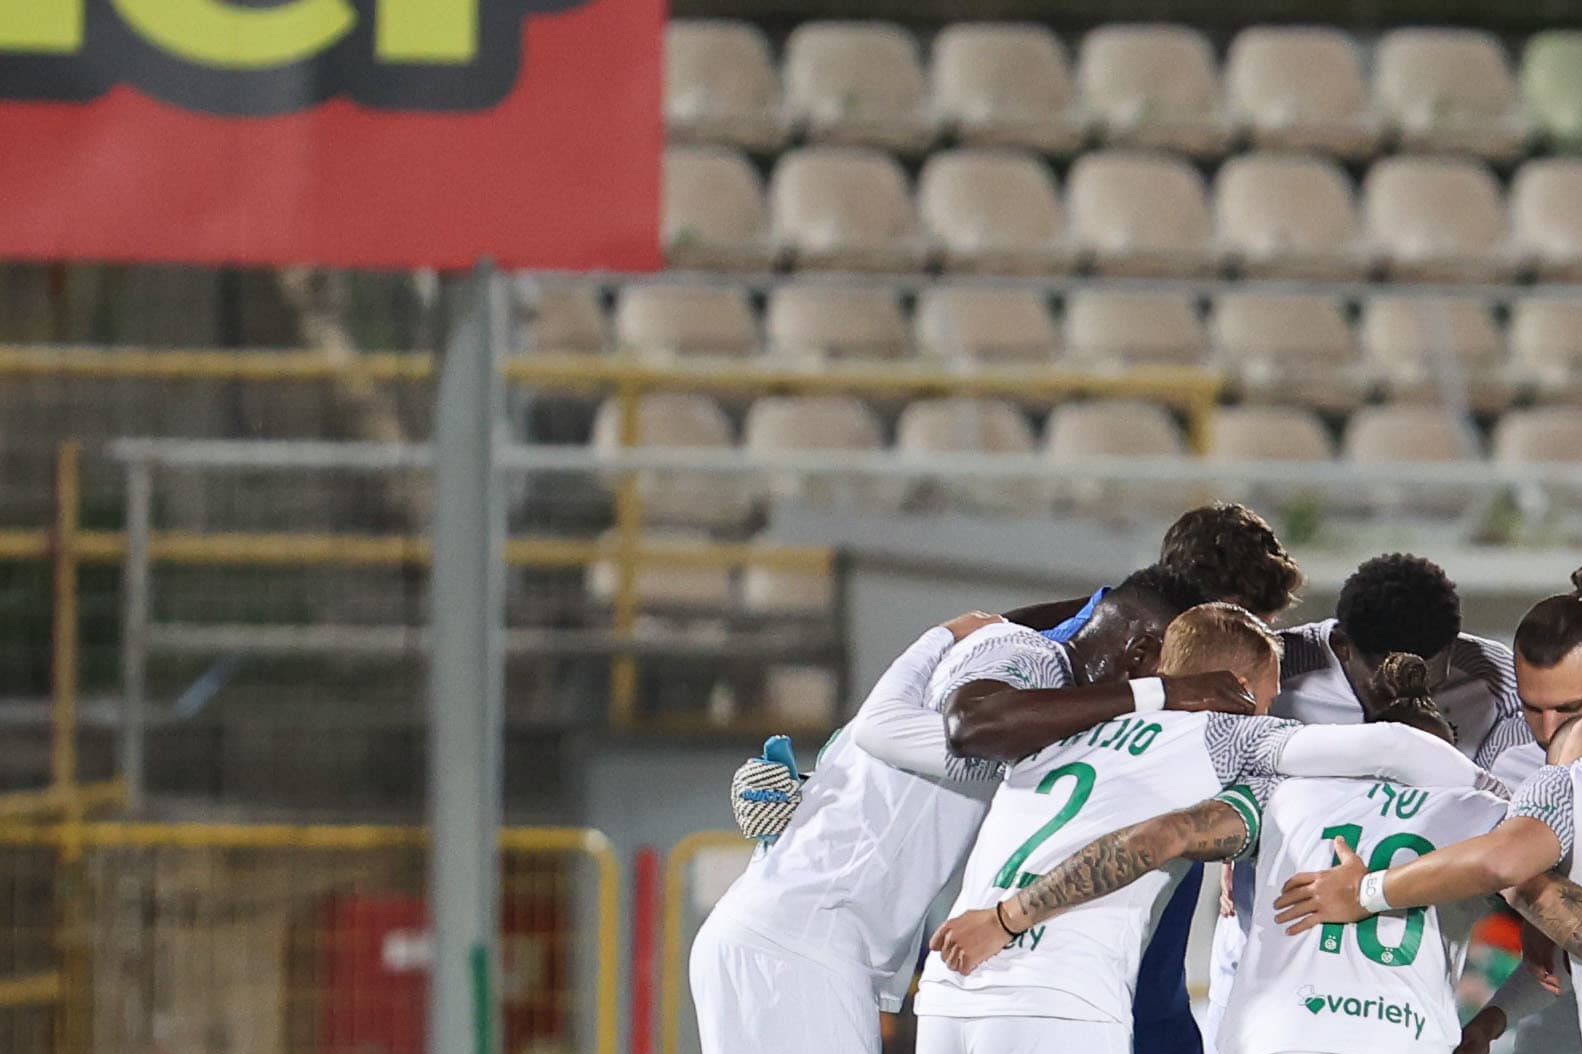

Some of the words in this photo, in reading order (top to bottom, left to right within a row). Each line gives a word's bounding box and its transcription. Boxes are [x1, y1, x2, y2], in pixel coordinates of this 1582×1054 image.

[993, 761, 1097, 889] 2
[1319, 823, 1439, 967] 10
[1327, 994, 1426, 1041] variety
